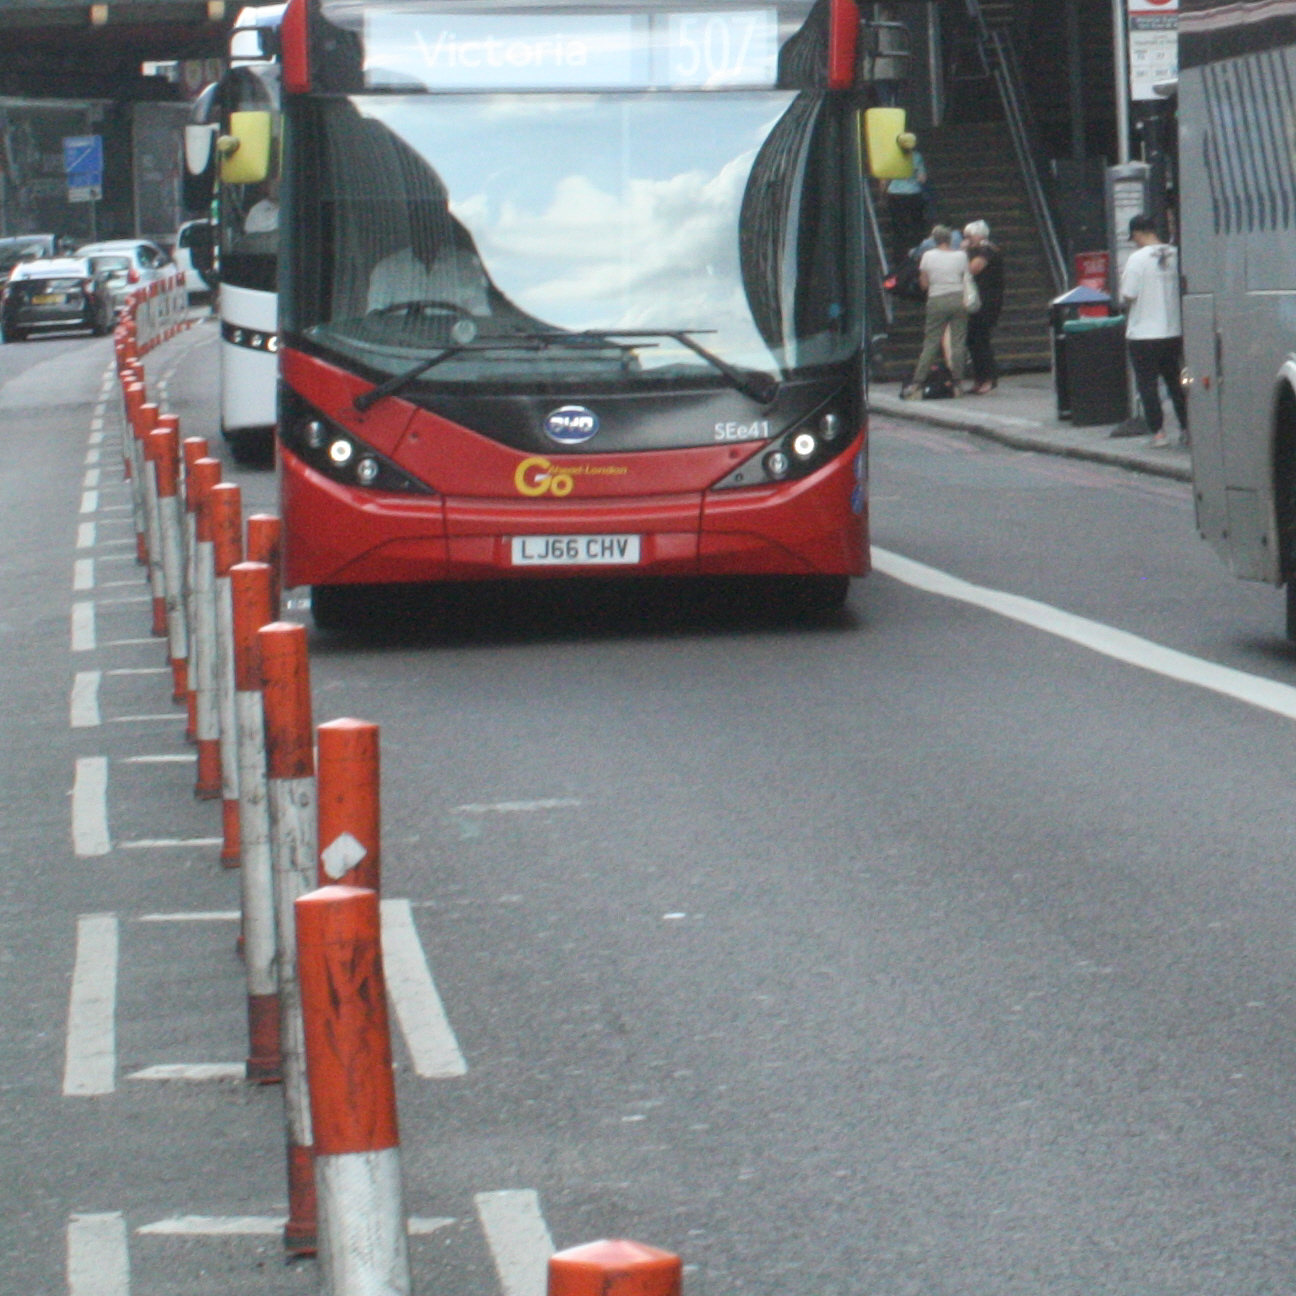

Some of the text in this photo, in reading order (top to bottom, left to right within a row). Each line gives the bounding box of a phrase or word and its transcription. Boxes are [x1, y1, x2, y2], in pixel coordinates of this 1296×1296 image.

[414, 17, 758, 77] Victoria 507
[713, 421, 770, 440] SEe41
[514, 456, 574, 497] Go
[521, 538, 629, 559] LJ66 CHV
